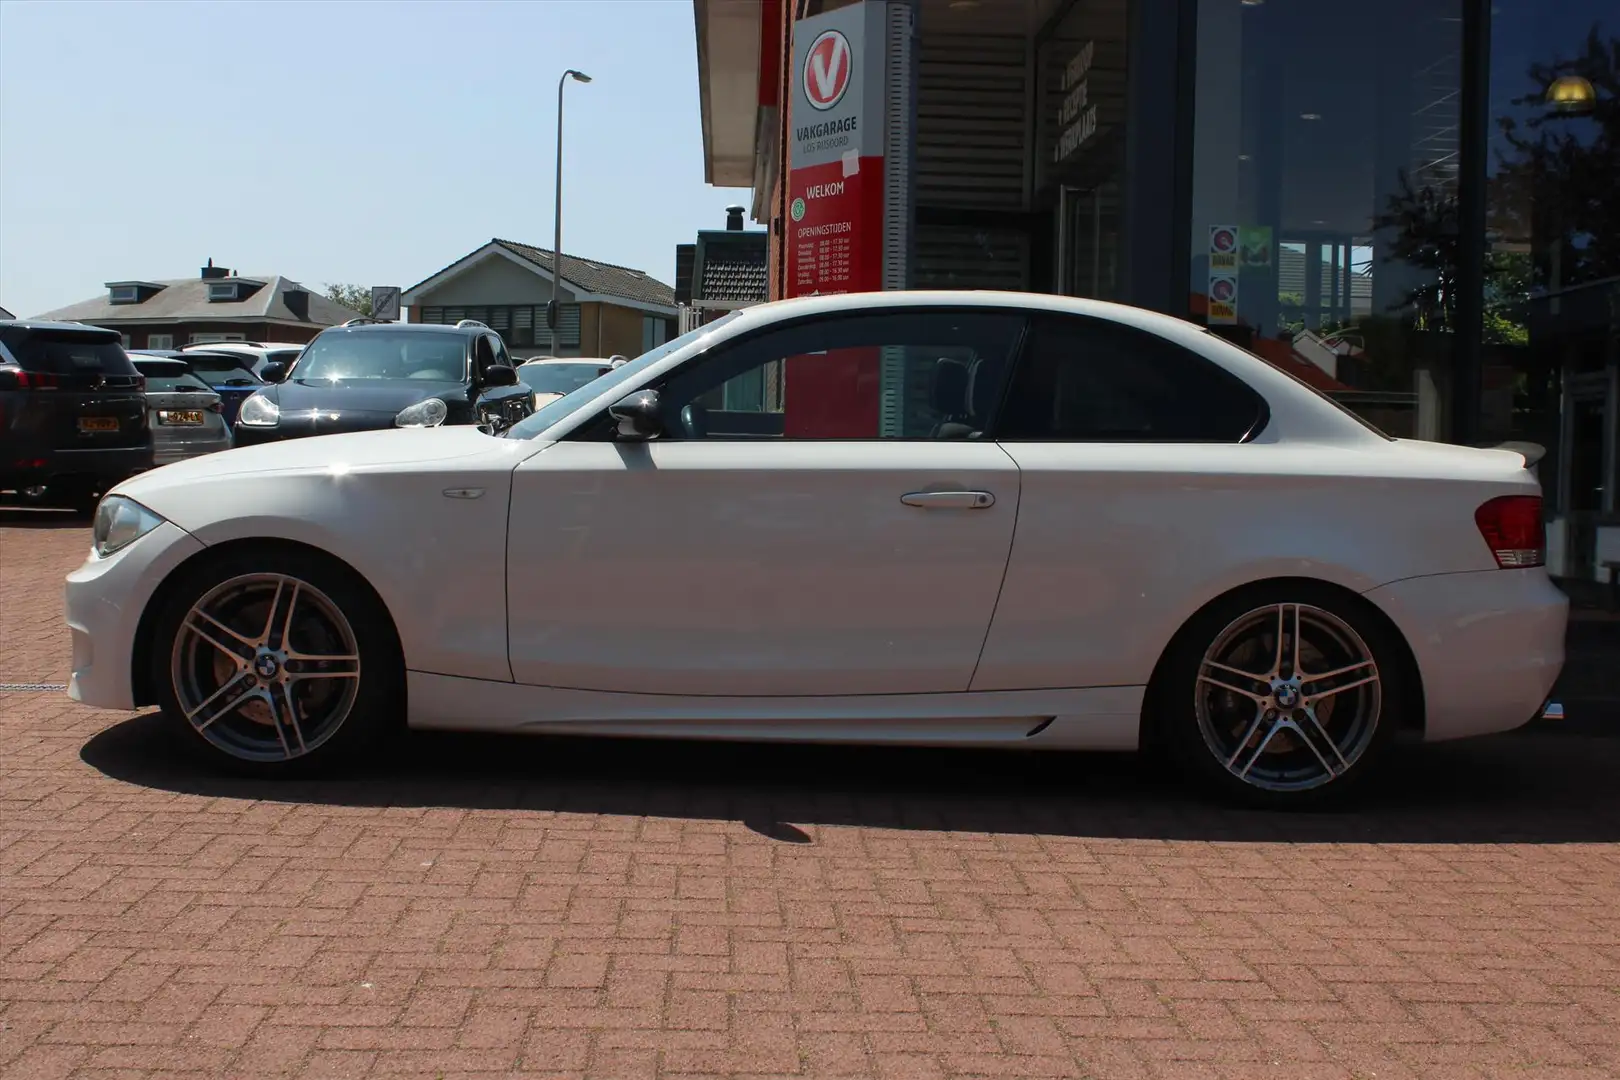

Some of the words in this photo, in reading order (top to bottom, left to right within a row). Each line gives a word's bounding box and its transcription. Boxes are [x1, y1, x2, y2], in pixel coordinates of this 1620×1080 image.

[796, 116, 857, 142] VAKGARAGE
[803, 142, 816, 154] LOS
[806, 181, 844, 200] WELKOM
[798, 221, 852, 239] OPENINGSTIJDEN
